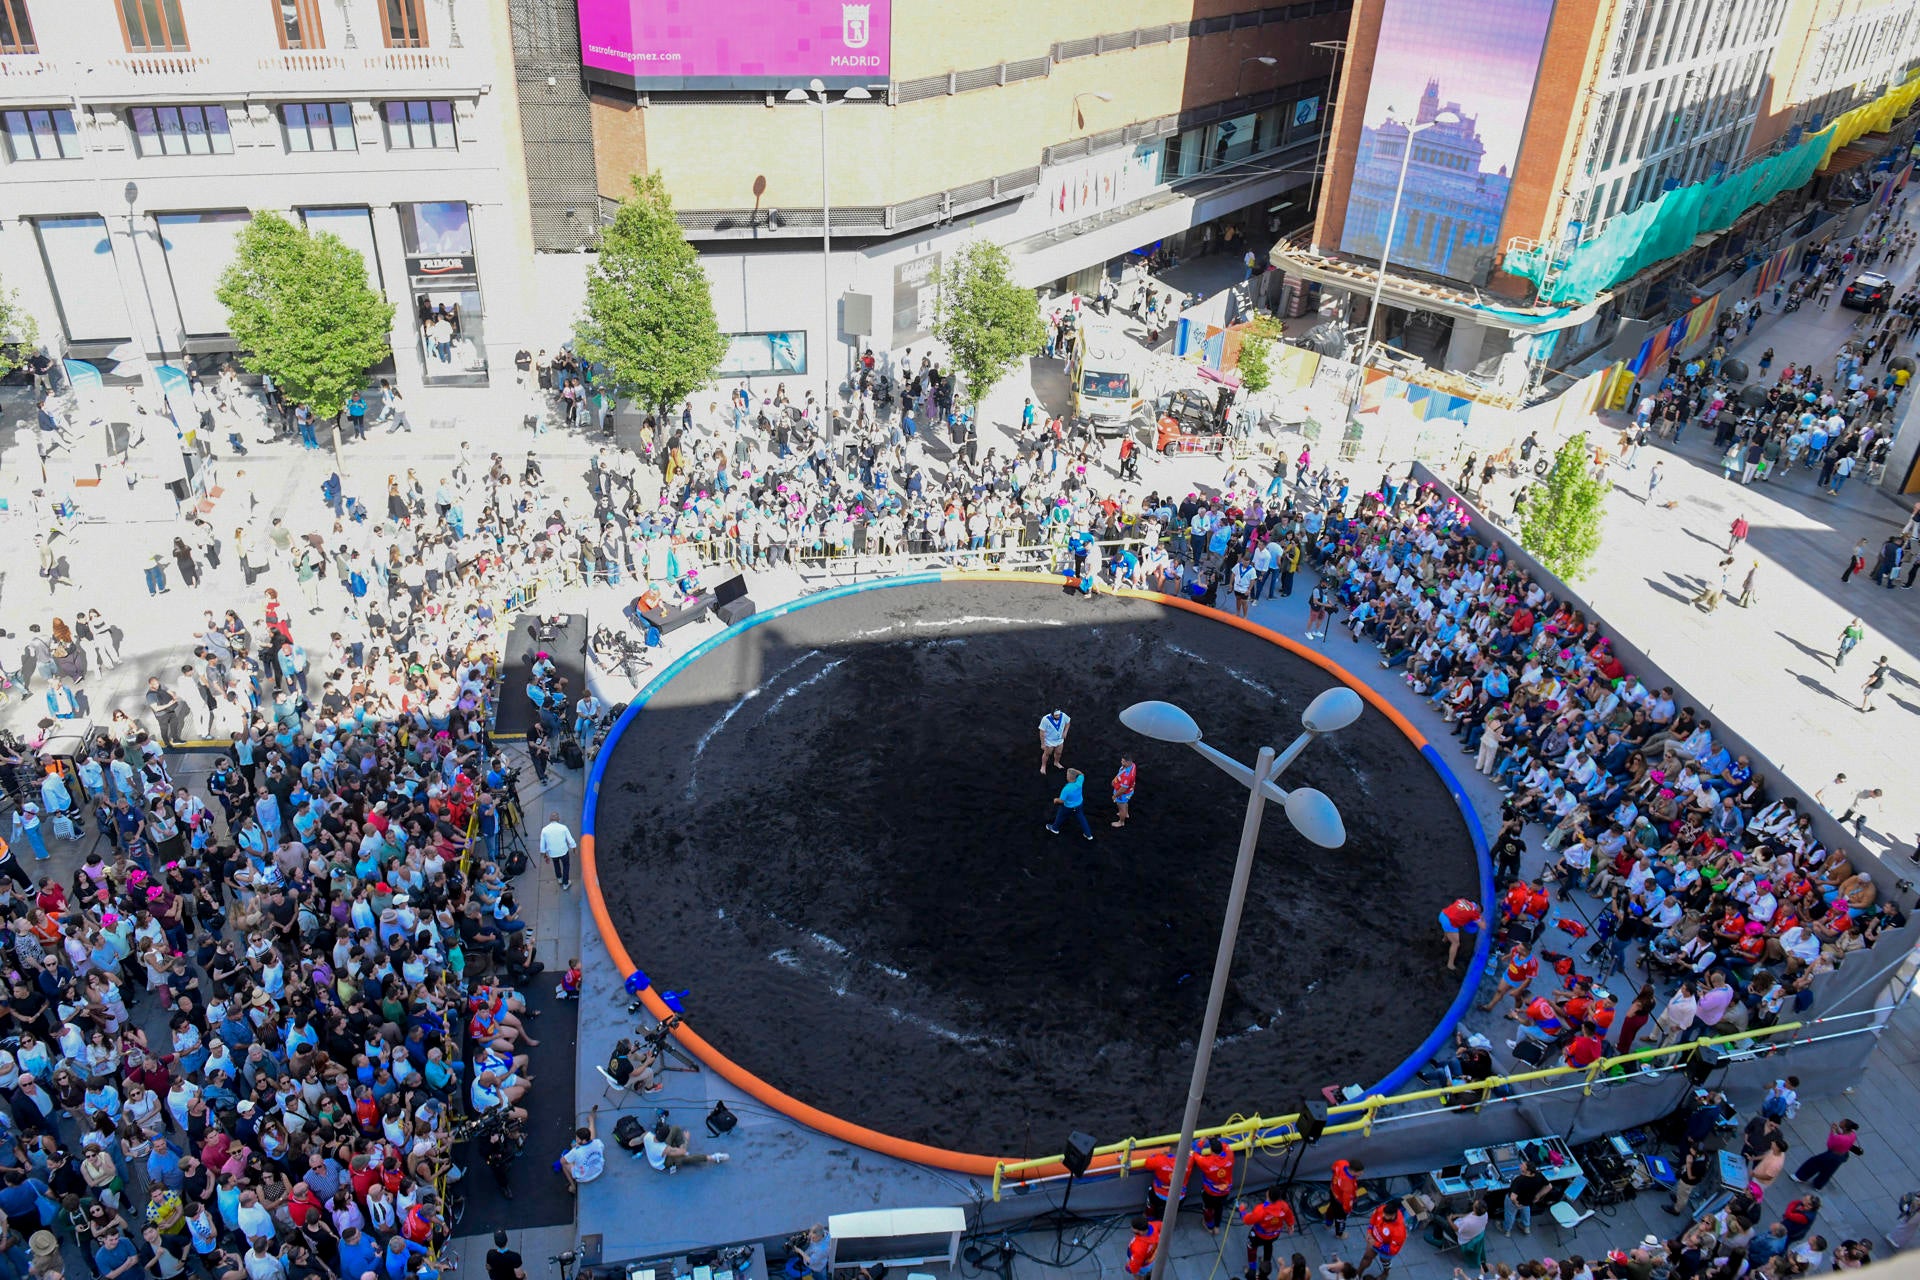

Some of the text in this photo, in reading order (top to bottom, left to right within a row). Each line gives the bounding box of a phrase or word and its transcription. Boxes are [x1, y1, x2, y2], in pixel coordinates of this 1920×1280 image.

[831, 55, 880, 66] MADRID
[151, 121, 217, 134] CLINQUE
[419, 258, 463, 270] PRIMOR
